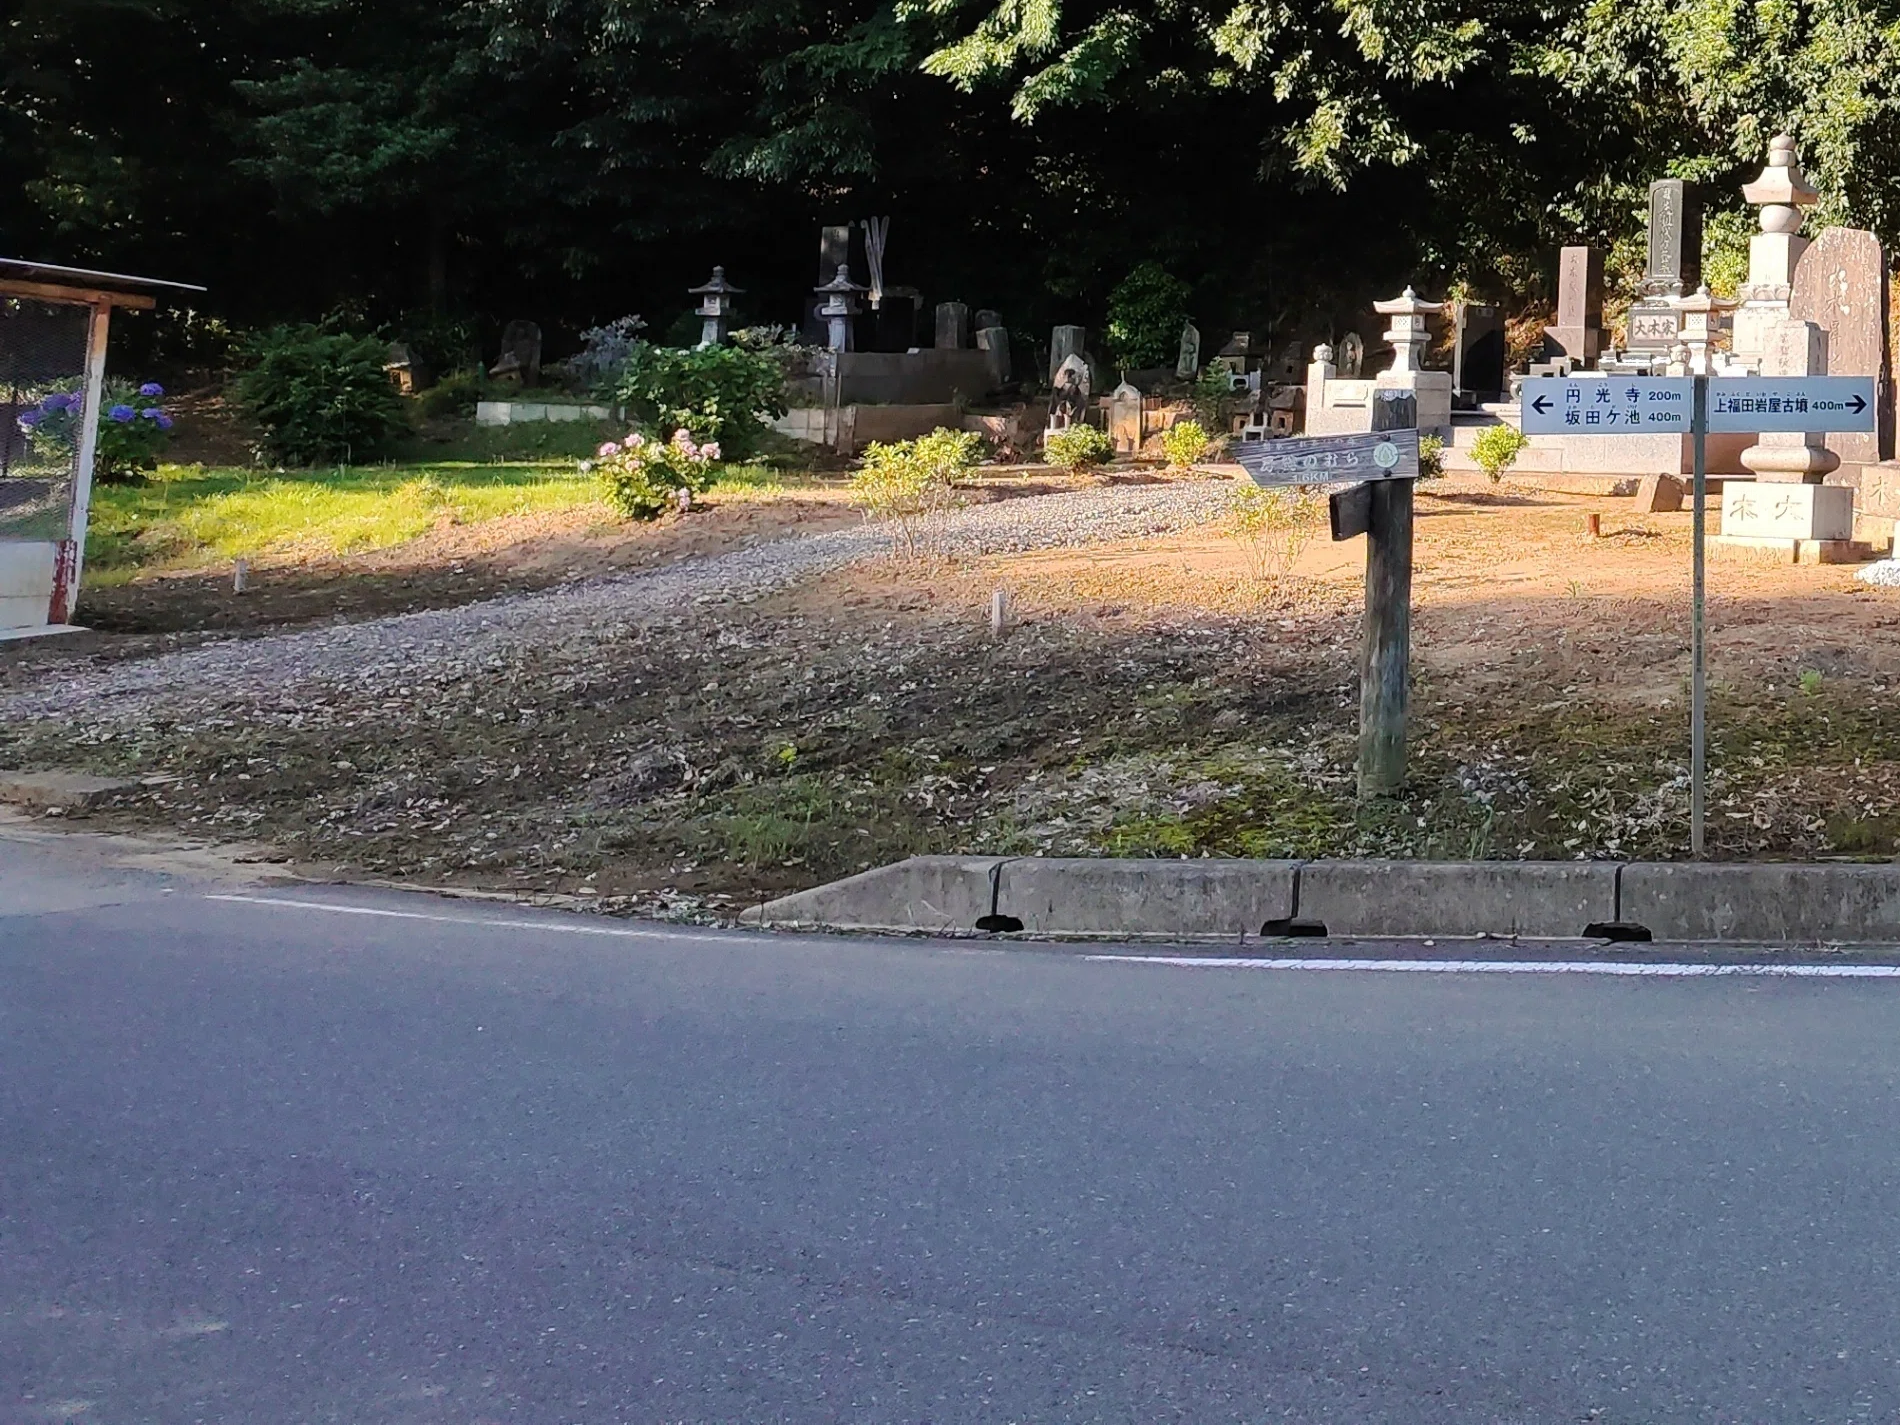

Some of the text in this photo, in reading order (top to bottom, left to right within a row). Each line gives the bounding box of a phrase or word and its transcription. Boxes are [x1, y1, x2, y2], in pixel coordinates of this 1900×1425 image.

[1634, 318, 1676, 336] 大木家
[1566, 388, 1681, 404] 円光寺 200m
[1714, 398, 1844, 413] 上福田岩屋古墳 400m
[1649, 412, 1681, 422] 400m
